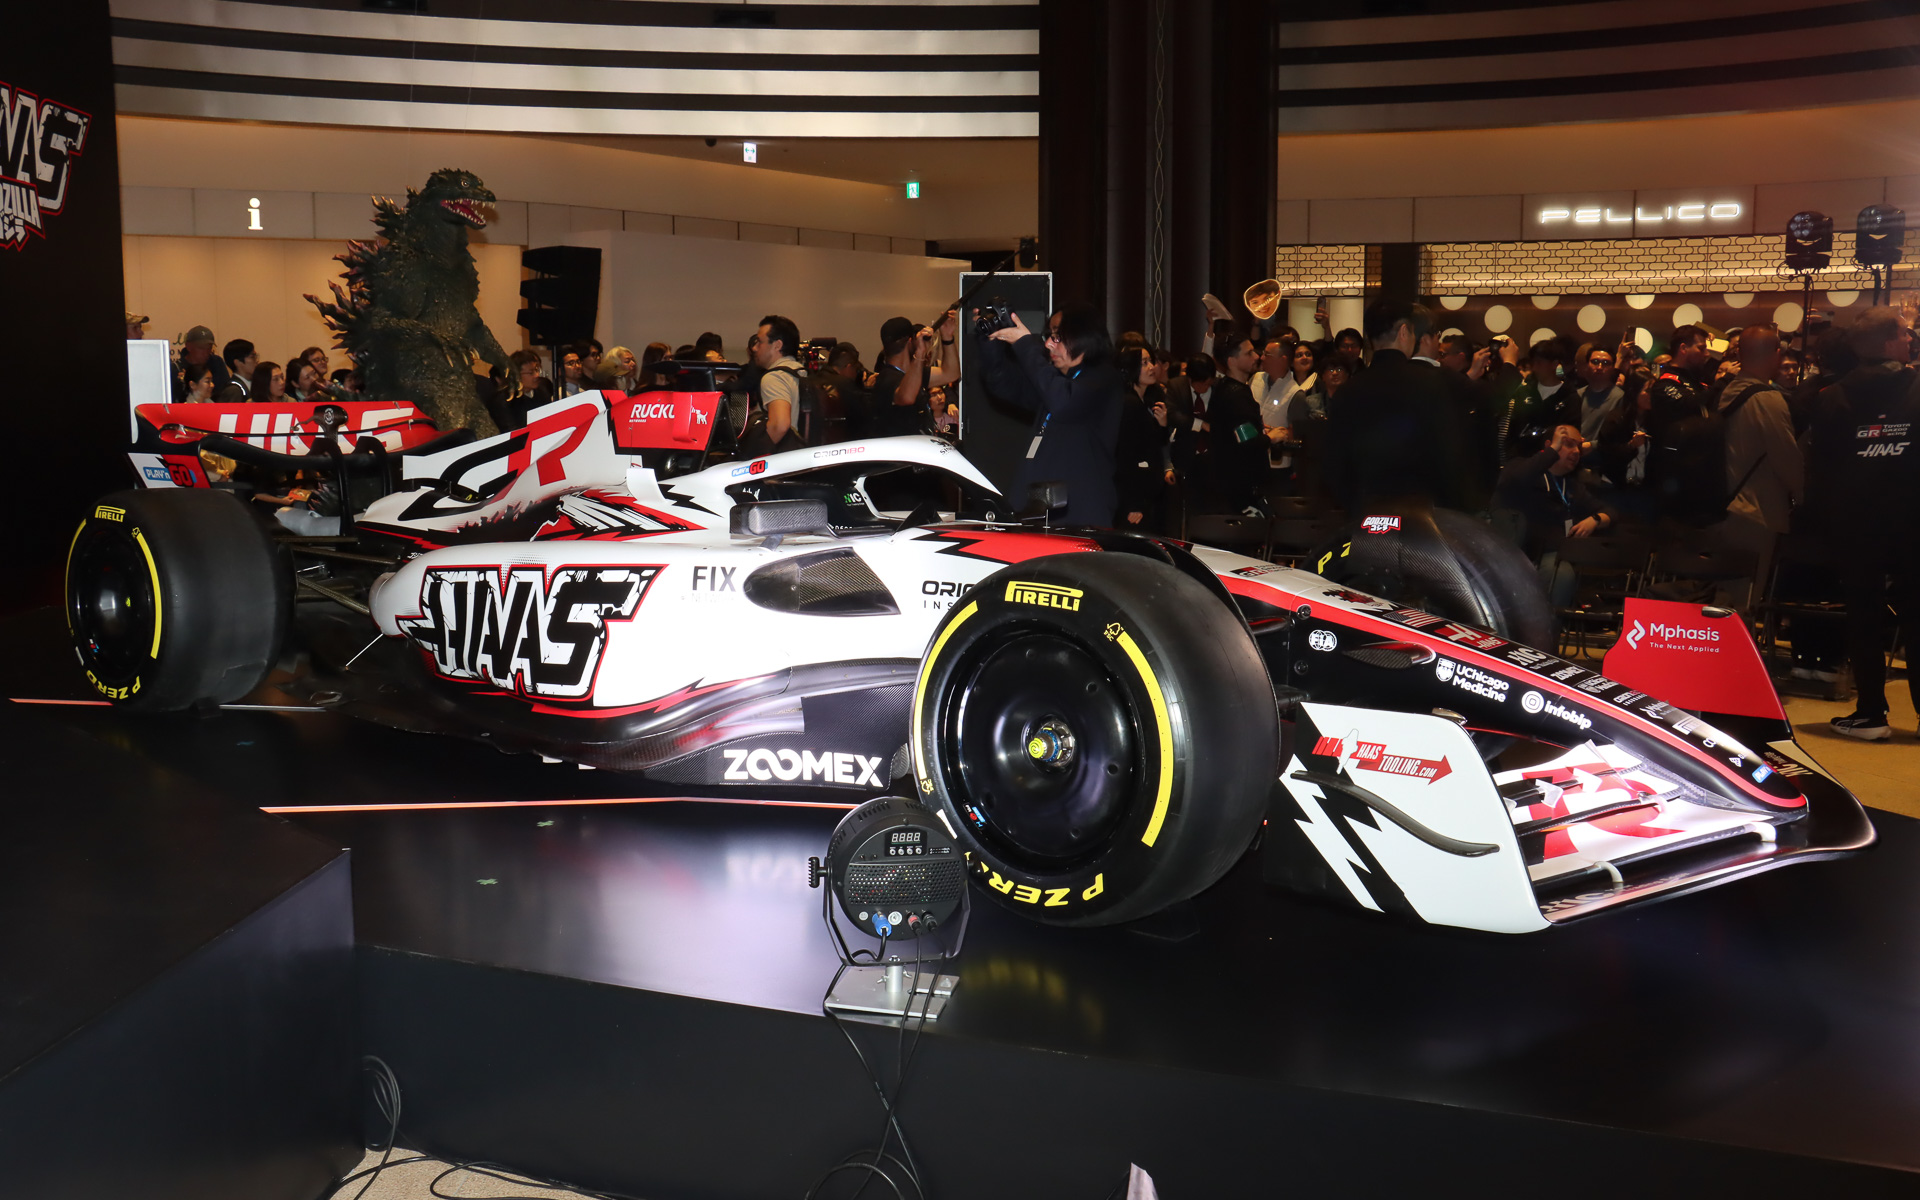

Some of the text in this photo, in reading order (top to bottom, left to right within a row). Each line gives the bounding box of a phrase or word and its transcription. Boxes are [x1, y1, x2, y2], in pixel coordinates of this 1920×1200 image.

[0, 182, 42, 230] ZILLA
[1541, 203, 1740, 224] PELLICO
[1857, 430, 1880, 438] GR
[1857, 441, 1911, 458] HAAS
[168, 463, 194, 486] GO
[749, 460, 766, 475] GO
[94, 505, 126, 523] PIRELLI
[1362, 516, 1399, 528] GODZILLA
[1317, 551, 1333, 575] P
[691, 565, 737, 592] FIX
[1004, 580, 1084, 612] PIRELLI
[396, 569, 656, 697] HAAS
[1649, 622, 1720, 642] Mphasis
[1649, 641, 1720, 653] The Next Applied
[86, 669, 141, 700] P ZERO
[1451, 675, 1507, 703] Medicine
[1455, 663, 1510, 692] UChicago
[1543, 700, 1592, 730] infobip
[1356, 743, 1383, 760] HAAS
[723, 748, 884, 788] ZOOMEX
[963, 851, 1104, 907] P ZER
